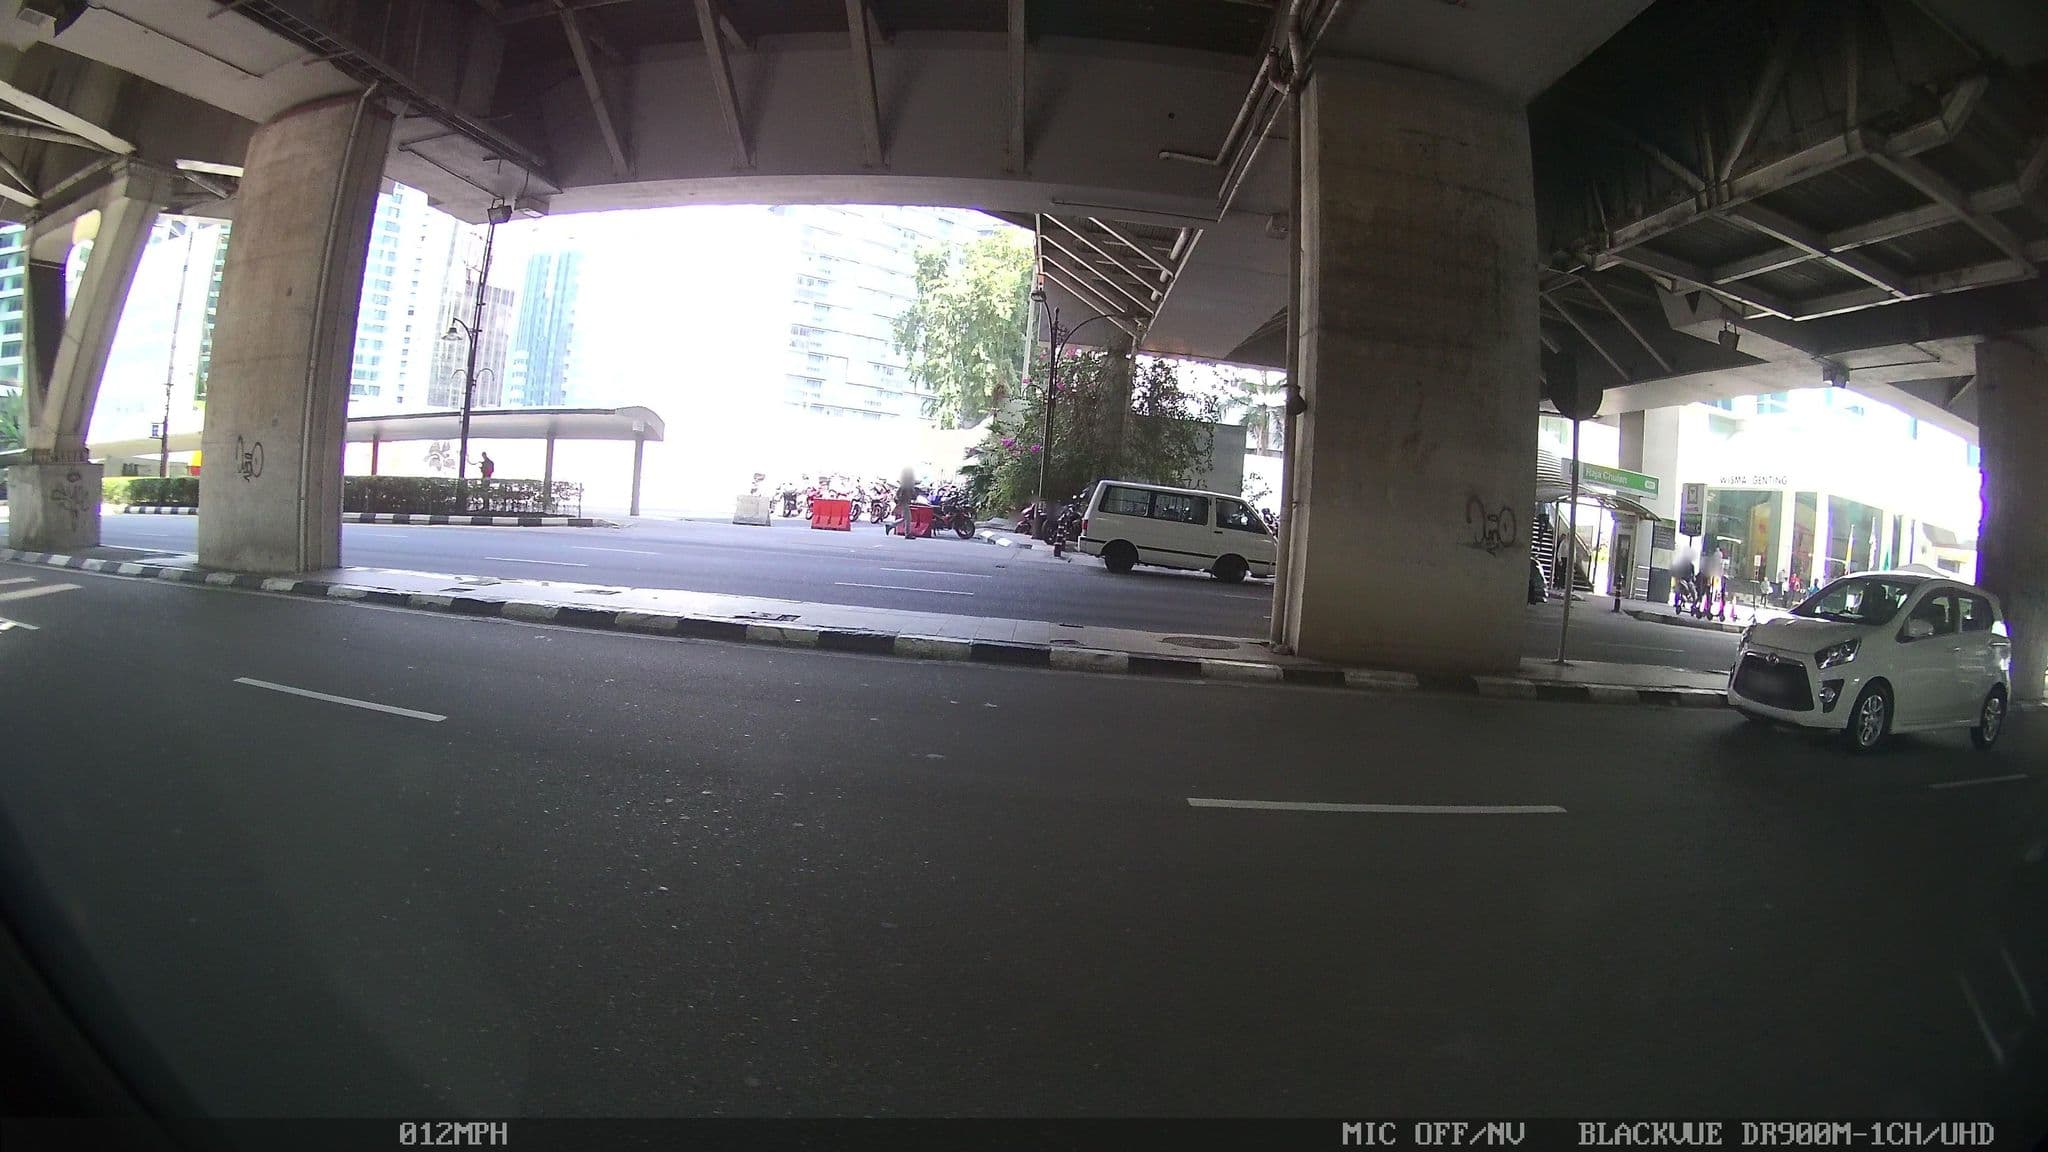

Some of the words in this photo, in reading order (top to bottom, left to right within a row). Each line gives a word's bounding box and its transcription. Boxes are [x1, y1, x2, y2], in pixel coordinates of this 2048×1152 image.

[1585, 467, 1602, 480] Raja
[1603, 471, 1628, 485] Chulan
[1720, 475, 1747, 485] WISMA
[1753, 475, 1788, 486] GENTING
